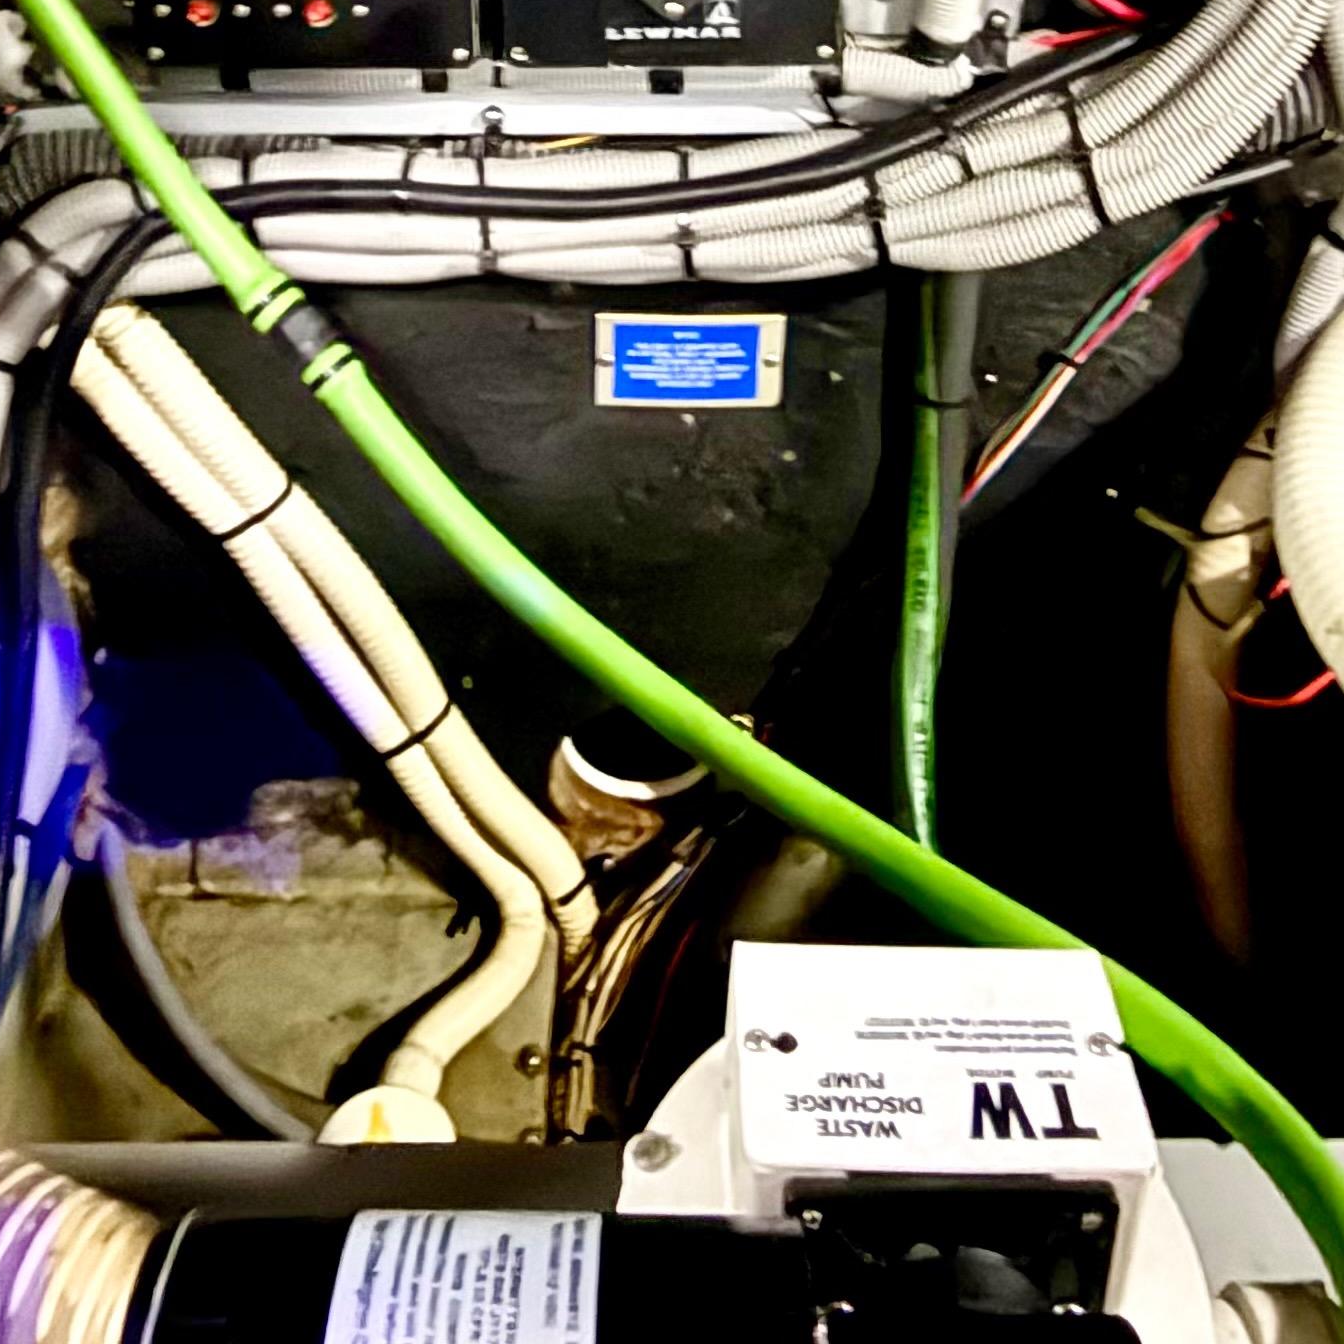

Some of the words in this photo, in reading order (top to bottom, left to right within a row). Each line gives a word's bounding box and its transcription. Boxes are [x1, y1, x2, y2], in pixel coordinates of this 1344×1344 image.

[817, 1072, 886, 1089] PUMP
[784, 1094, 925, 1115] DISCHARGE
[968, 1082, 1102, 1141] TW
[816, 1118, 903, 1139] WASTE
